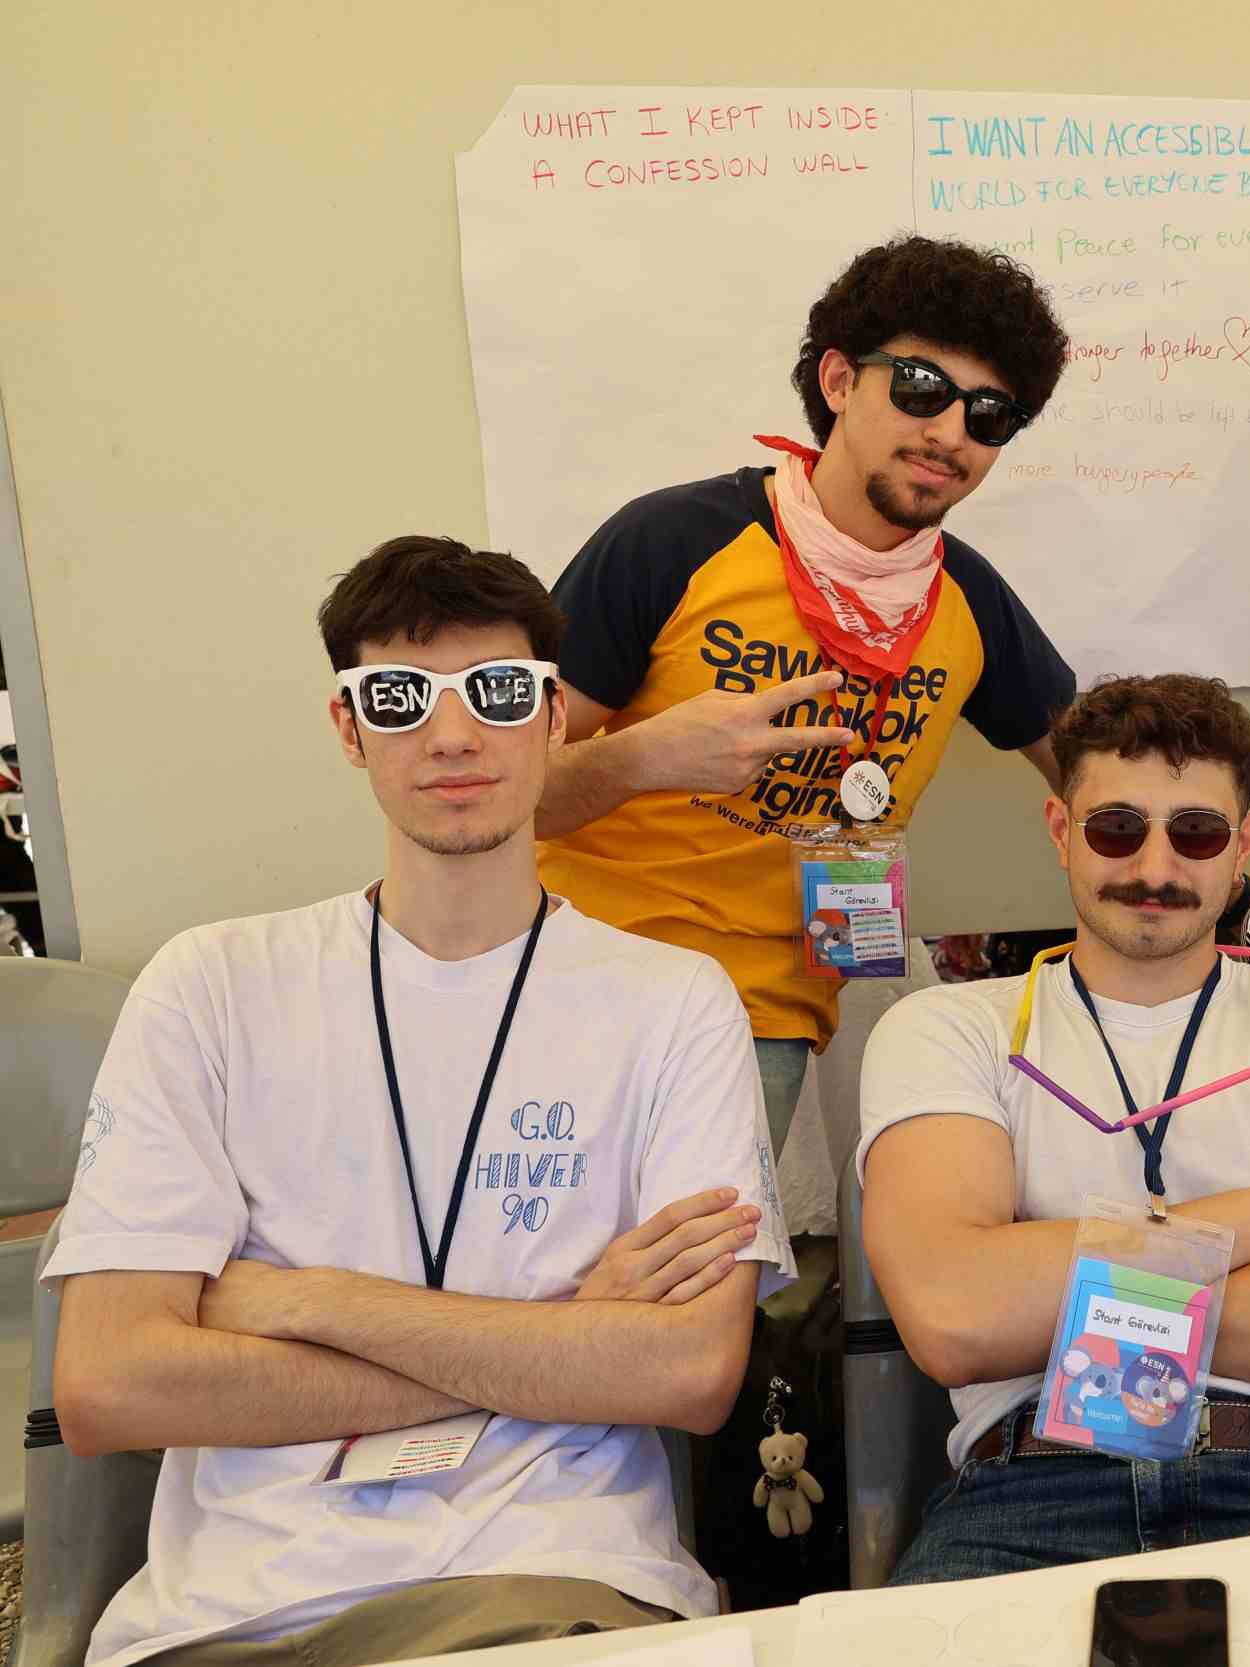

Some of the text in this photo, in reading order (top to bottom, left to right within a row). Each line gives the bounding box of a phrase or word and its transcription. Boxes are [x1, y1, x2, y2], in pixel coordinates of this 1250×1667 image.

[522, 109, 617, 139] WHAT
[638, 106, 669, 137] I
[687, 105, 763, 137] KEPT
[928, 116, 956, 156] I
[961, 116, 1047, 158] WANT
[1055, 117, 1096, 157] AN
[531, 151, 870, 190] A CONFESSION WALL
[928, 178, 1026, 213] WORLD
[1036, 177, 1092, 204] FOR
[1104, 169, 1230, 198] EVERYONE
[1055, 227, 1139, 266] Peace
[1059, 329, 1225, 382] tronger together
[371, 682, 431, 713] ESN
[863, 780, 885, 805] ESN
[717, 804, 757, 831] were
[502, 1193, 549, 1235] 90
